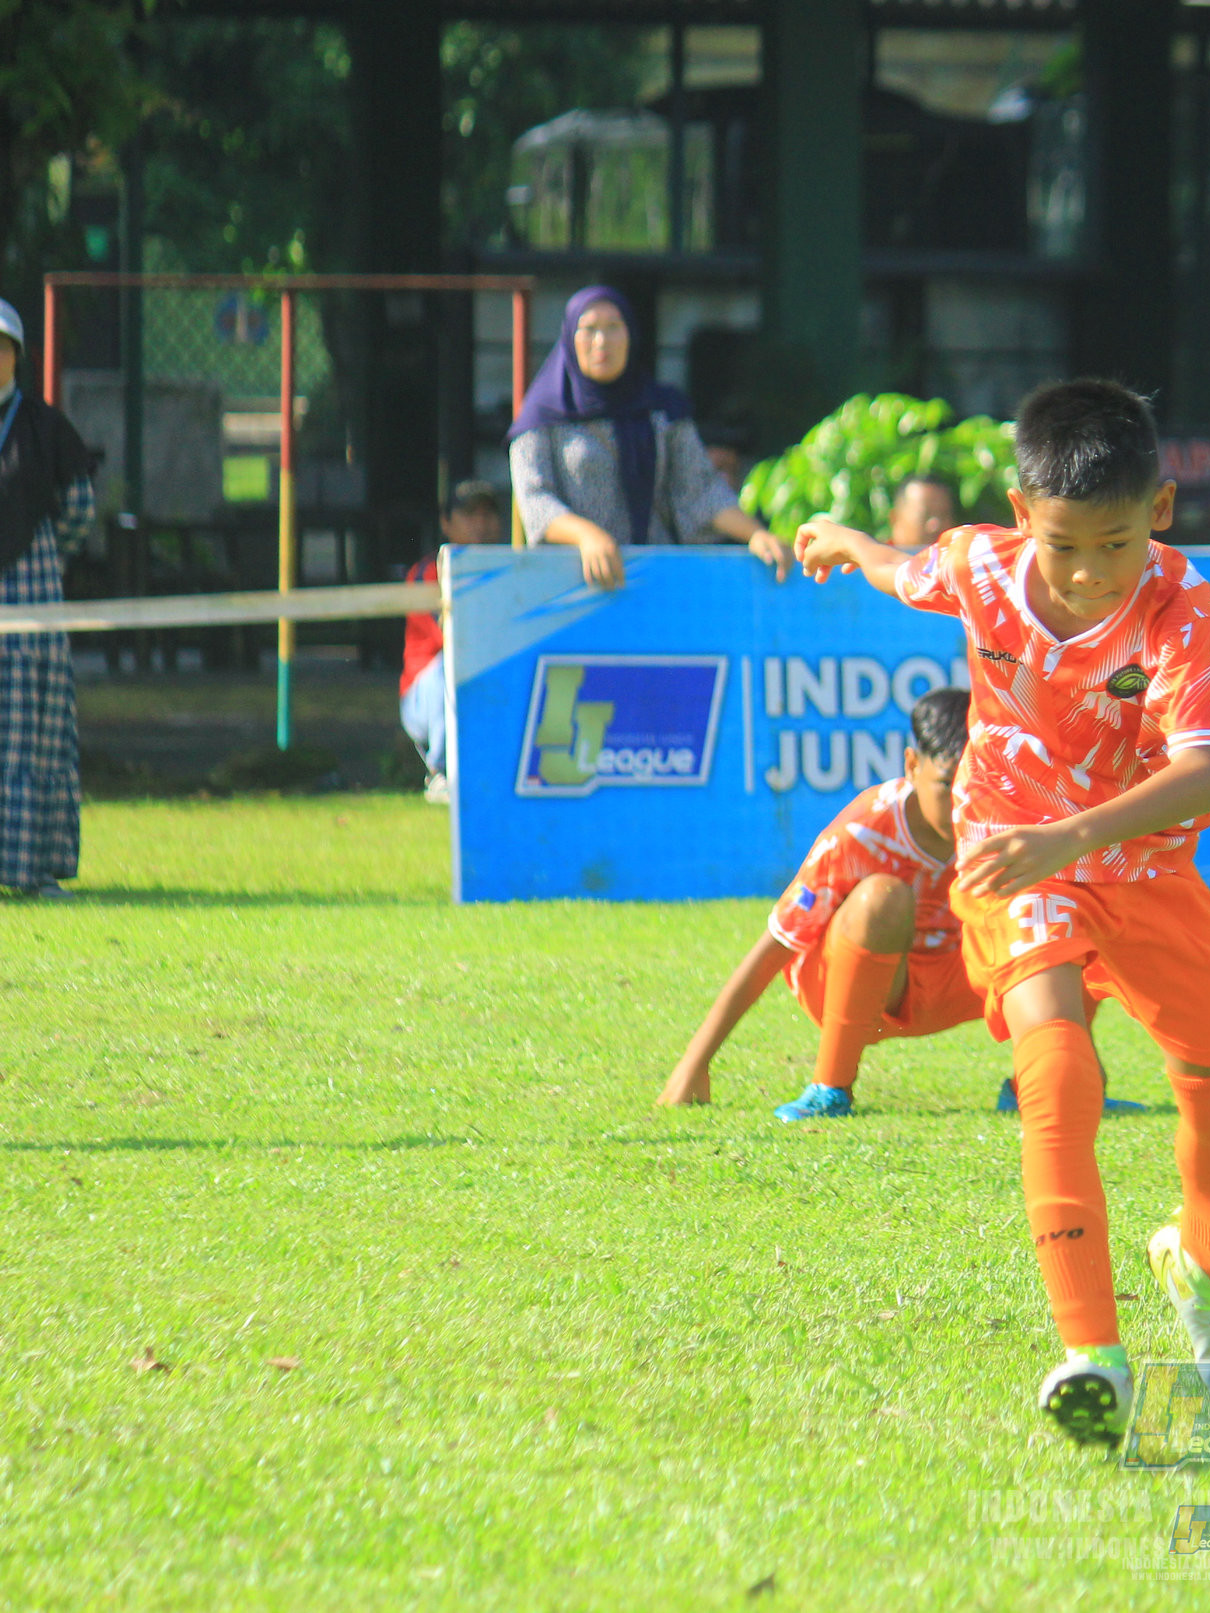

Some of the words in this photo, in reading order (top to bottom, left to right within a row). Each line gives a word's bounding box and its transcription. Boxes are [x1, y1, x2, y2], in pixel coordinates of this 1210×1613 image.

[577, 739, 693, 782] League
[764, 730, 916, 793] JUN
[1008, 893, 1078, 957] 35
